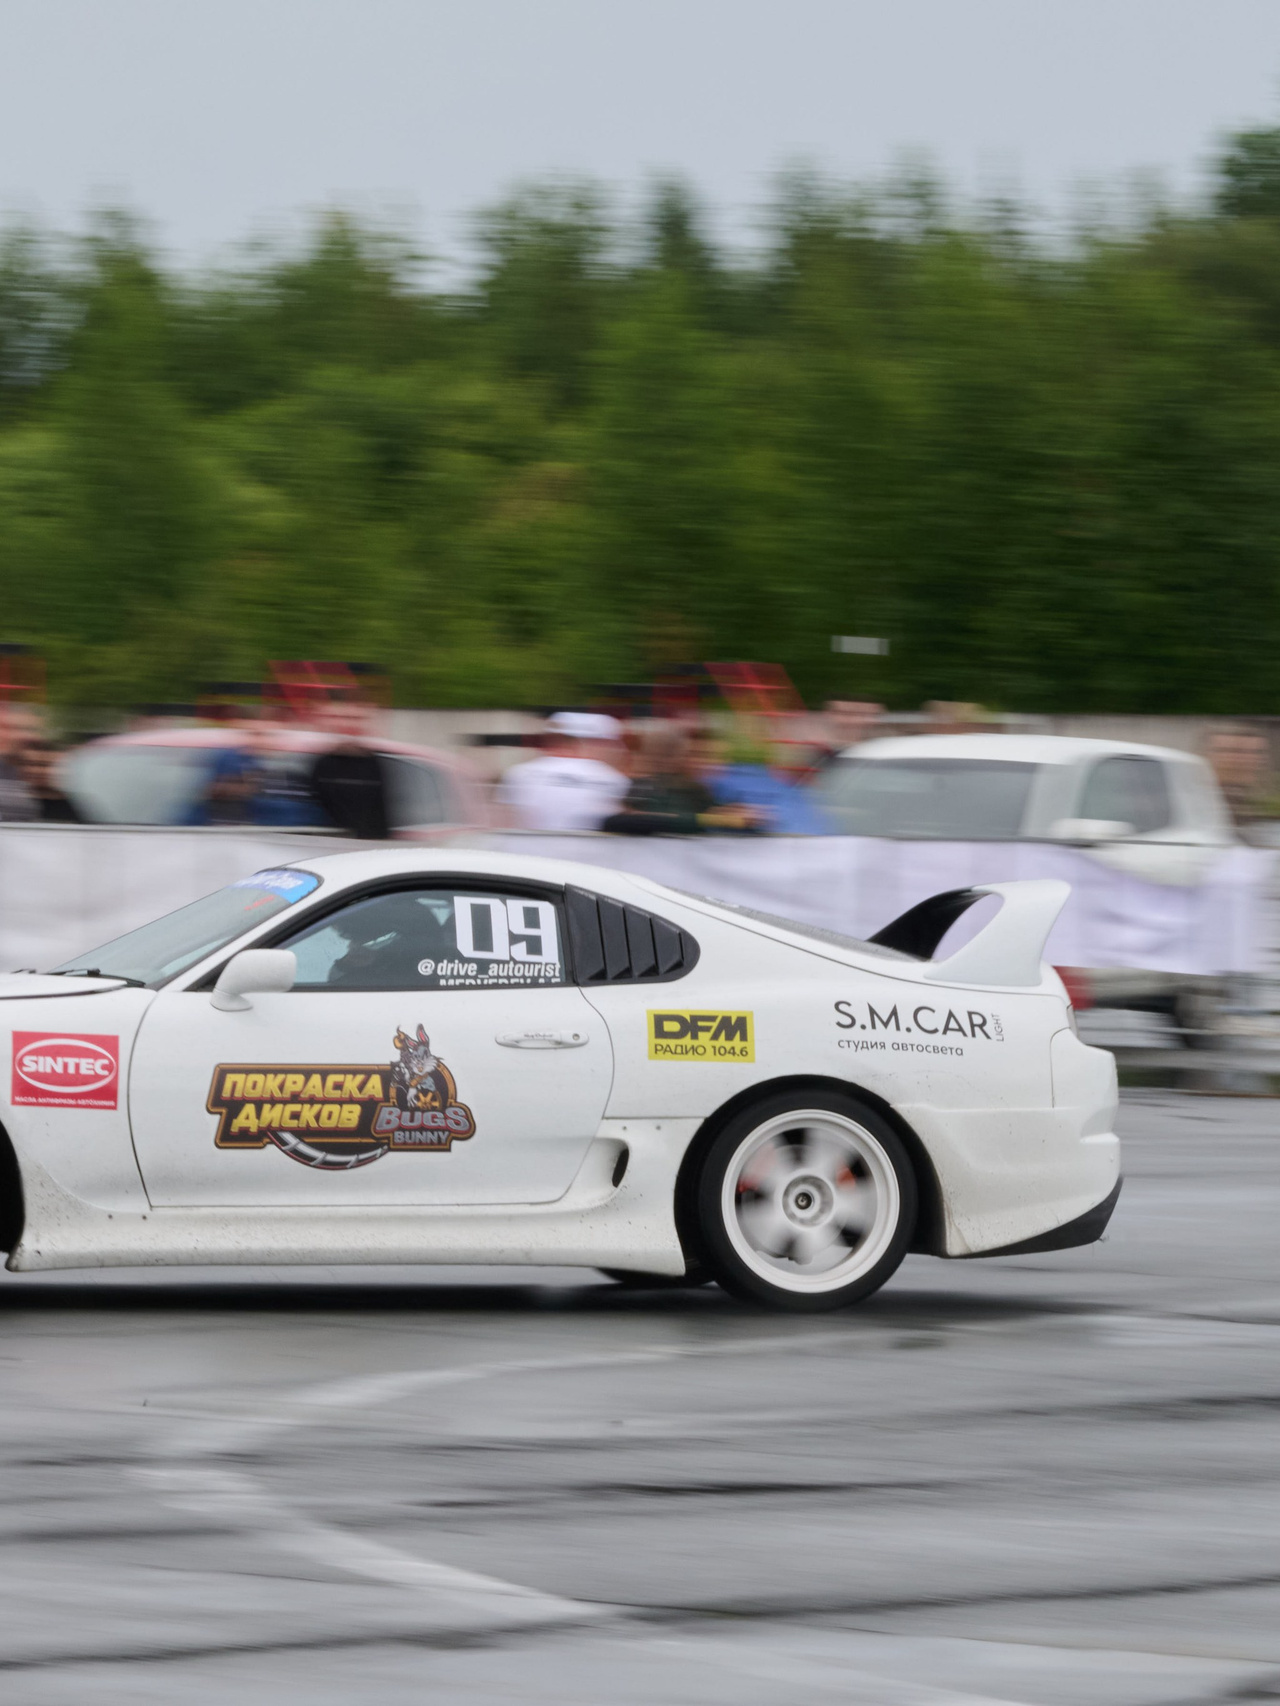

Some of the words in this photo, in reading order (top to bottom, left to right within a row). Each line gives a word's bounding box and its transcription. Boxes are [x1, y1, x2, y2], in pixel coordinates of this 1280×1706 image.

[453, 896, 559, 963] 09
[417, 958, 561, 978] @drive_autourist
[653, 1013, 748, 1042] DFM
[834, 1000, 992, 1040] S.M.CAR
[991, 1013, 1005, 1042] LIGHT
[654, 1043, 707, 1056] РАДИО
[711, 1045, 749, 1057] 104.6
[837, 1039, 886, 1053] студия
[891, 1042, 964, 1056] автосвета
[22, 1055, 110, 1076] SINTEC
[221, 1073, 385, 1100] ПОКРАСКА
[230, 1103, 362, 1134] ДИСКОВ
[393, 1131, 450, 1145] BUNNY
